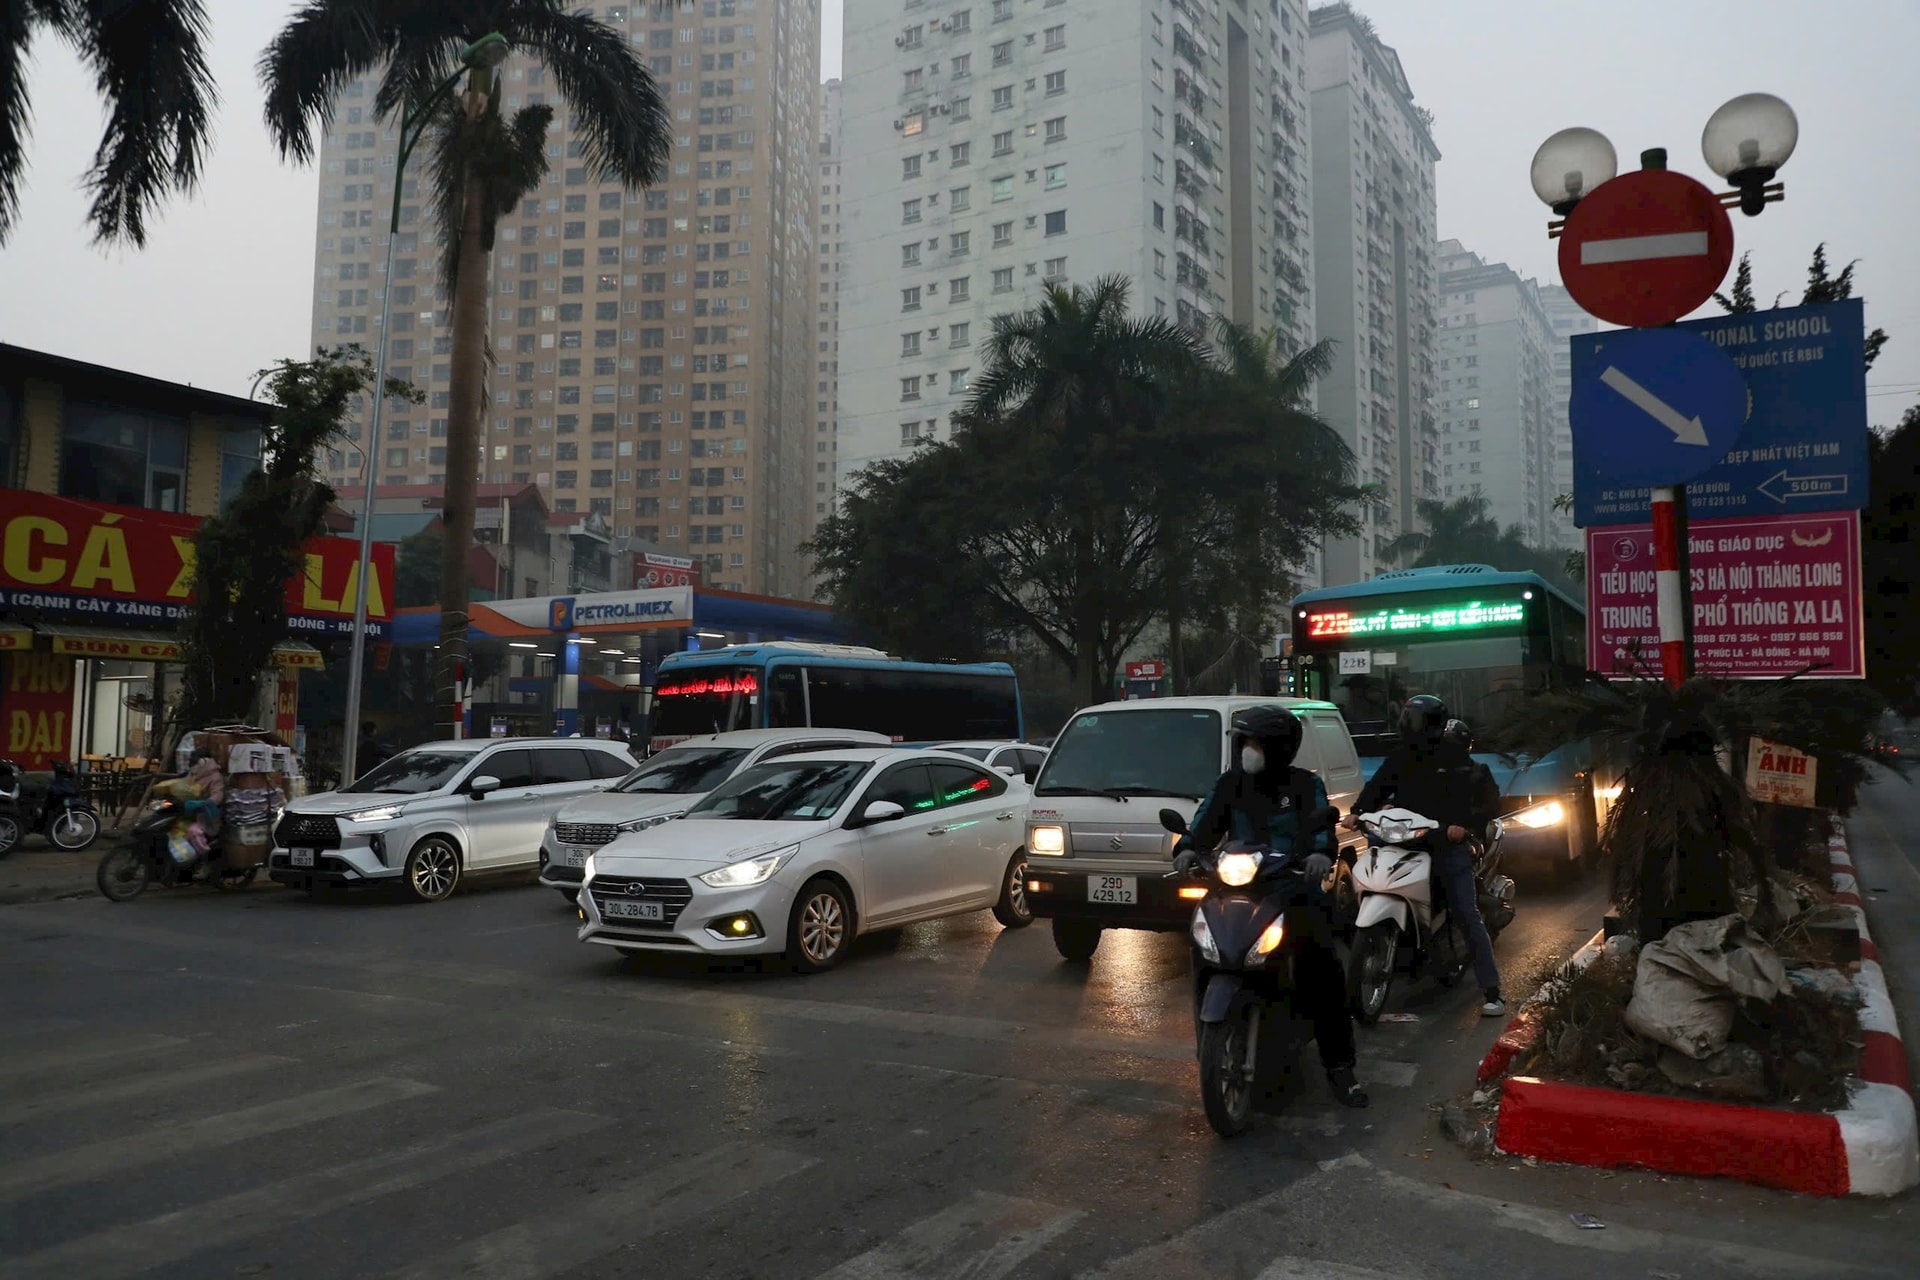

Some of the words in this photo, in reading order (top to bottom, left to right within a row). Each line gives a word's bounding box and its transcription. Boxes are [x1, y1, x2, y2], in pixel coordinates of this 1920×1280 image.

[1764, 316, 1831, 341] SCHOOL
[1748, 347, 1778, 368] QUỐC
[1782, 347, 1795, 364] TẾ
[1797, 347, 1824, 361] RBIS
[1727, 450, 1749, 466] ĐẸP
[1752, 443, 1782, 461] NHẤT
[1785, 441, 1810, 461] VIỆT
[1813, 442, 1840, 457] NAM
[1619, 488, 1635, 499] KHU
[1791, 480, 1831, 491] 500m
[1718, 535, 1751, 552] GIÁO
[1755, 536, 1784, 553] DỤC
[3, 512, 136, 593] CÁ
[303, 553, 386, 617] LA
[1600, 563, 1626, 595] TIỂU
[1630, 570, 1655, 598] HỌC
[1708, 563, 1725, 590] HÀ
[1730, 561, 1753, 595] NỘI
[1756, 561, 1801, 588] THĂNG
[1805, 562, 1843, 587] LONG
[12, 593, 70, 609] (CẠNH
[76, 598, 111, 612] CÂY
[116, 601, 161, 617] XĂNG
[288, 616, 325, 631] ĐÔNG
[338, 621, 354, 633] HÀ
[575, 601, 673, 620] PETROLIMEX
[1600, 605, 1652, 629] TRUNG
[1693, 594, 1727, 626] PHỔ
[1731, 597, 1788, 625] THÔNG
[1793, 600, 1817, 624] XA
[1821, 600, 1844, 624] LA
[1740, 633, 1759, 642] 354
[64, 640, 129, 655] BÚN
[1708, 647, 1731, 658] PHÚC
[1733, 648, 1744, 657] LA
[1751, 646, 1765, 657] HÀ
[1766, 646, 1790, 657] ĐÔNG
[1798, 646, 1811, 656] HÀ
[1813, 645, 1830, 658] NỘI
[1343, 659, 1366, 668] 22B
[1734, 659, 1759, 667] Thanh
[8, 709, 66, 764] ĐẠI
[1759, 746, 1807, 775] ẢNH
[1102, 878, 1123, 888] 29D
[1093, 890, 1132, 902] 429.12
